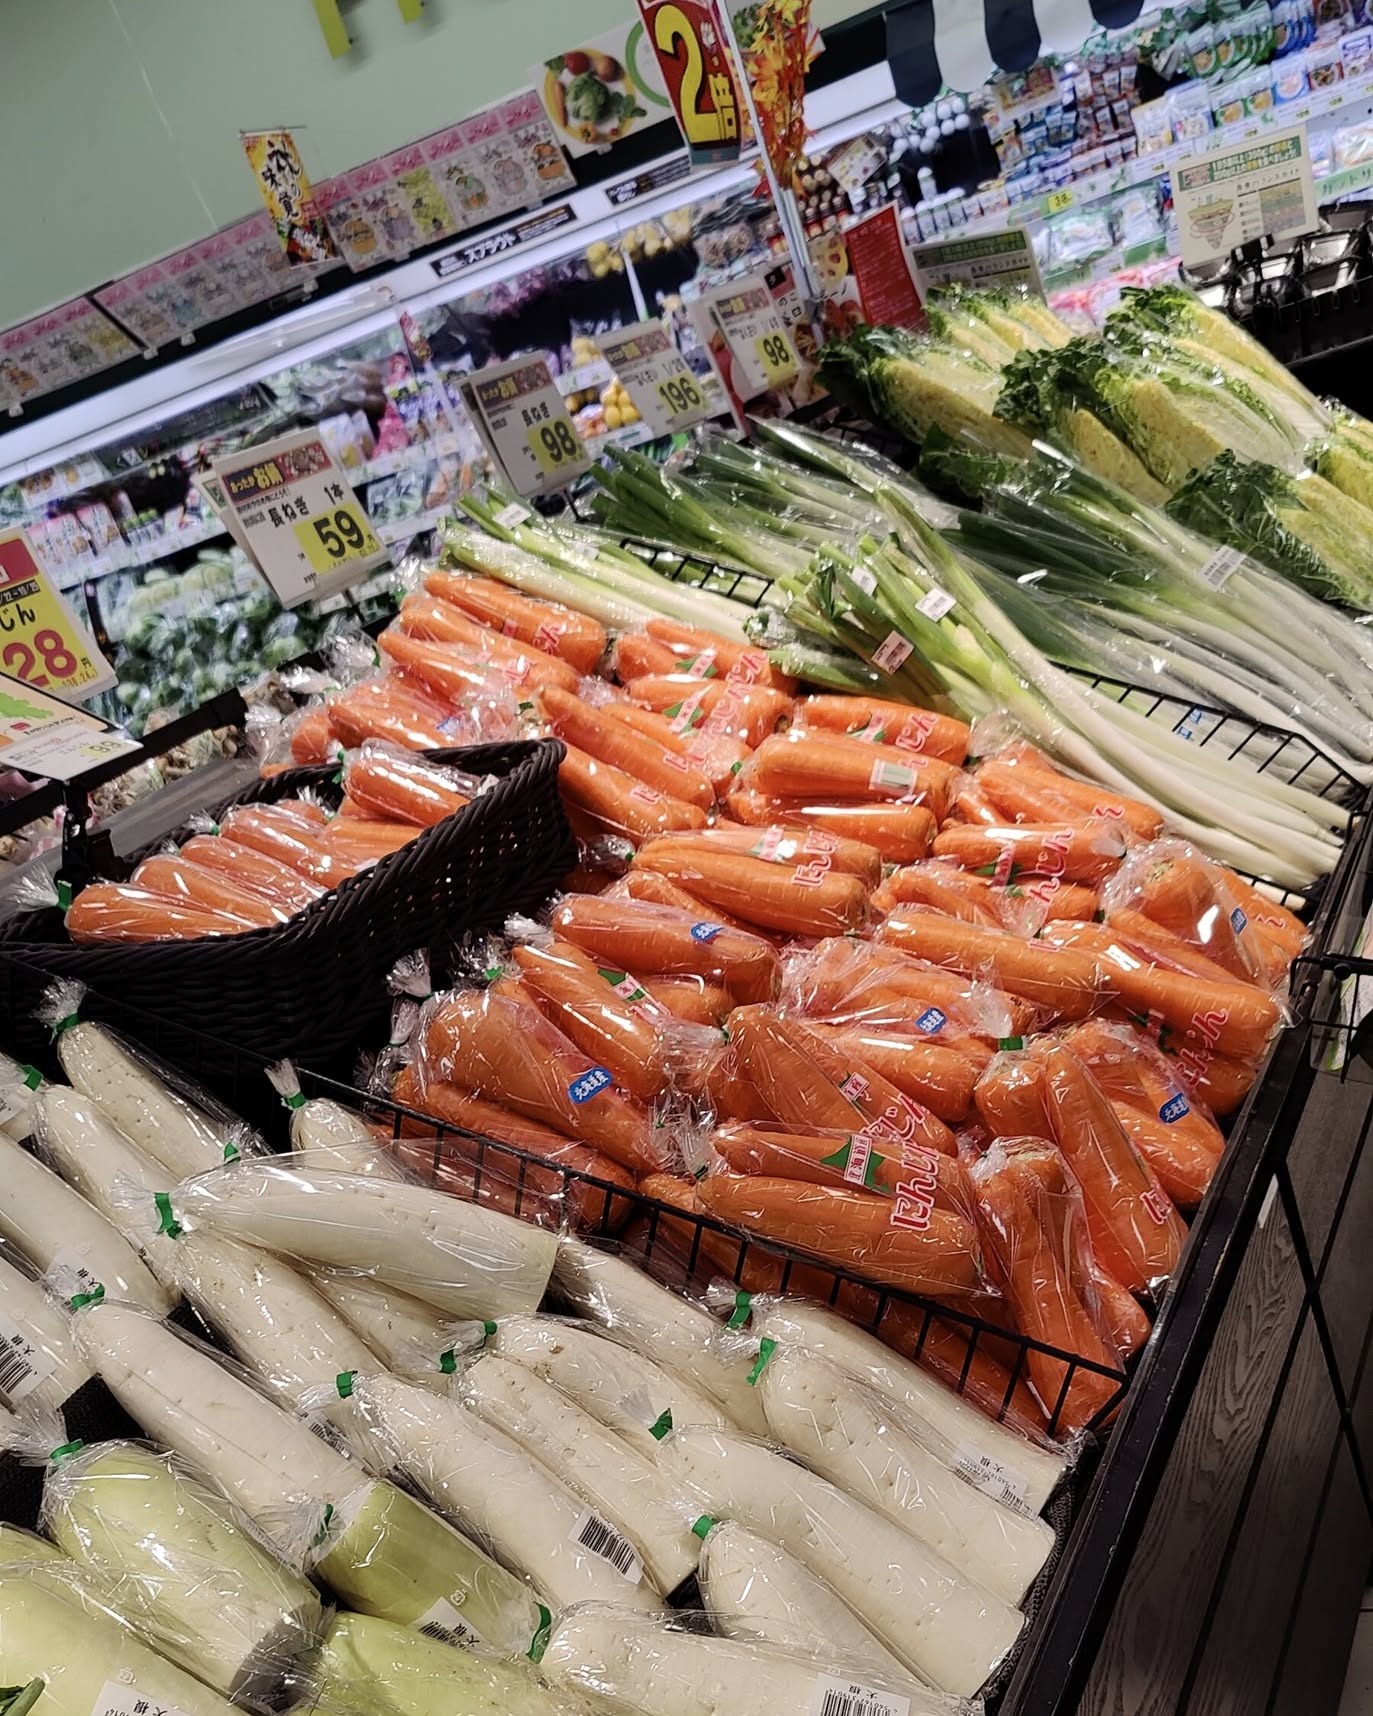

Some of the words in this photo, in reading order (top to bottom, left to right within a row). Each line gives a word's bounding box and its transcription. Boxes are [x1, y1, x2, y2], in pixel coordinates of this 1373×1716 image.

[762, 335, 790, 367] 98
[659, 377, 700, 415] 196
[521, 401, 550, 427] 長ねぎ
[540, 420, 577, 463] 98
[267, 496, 309, 529] 長ねぎ
[324, 483, 344, 506] 1本
[313, 510, 366, 559] 59
[792, 829, 842, 888] にんじ
[576, 1069, 609, 1098] 北海道産
[77, 1267, 101, 1287] 大根
[10, 1333, 36, 1356] 大根
[979, 1454, 1004, 1474] 大根
[452, 1622, 480, 1645] 大根
[848, 1684, 879, 1700] 大根
[133, 1698, 168, 1716] 大根
